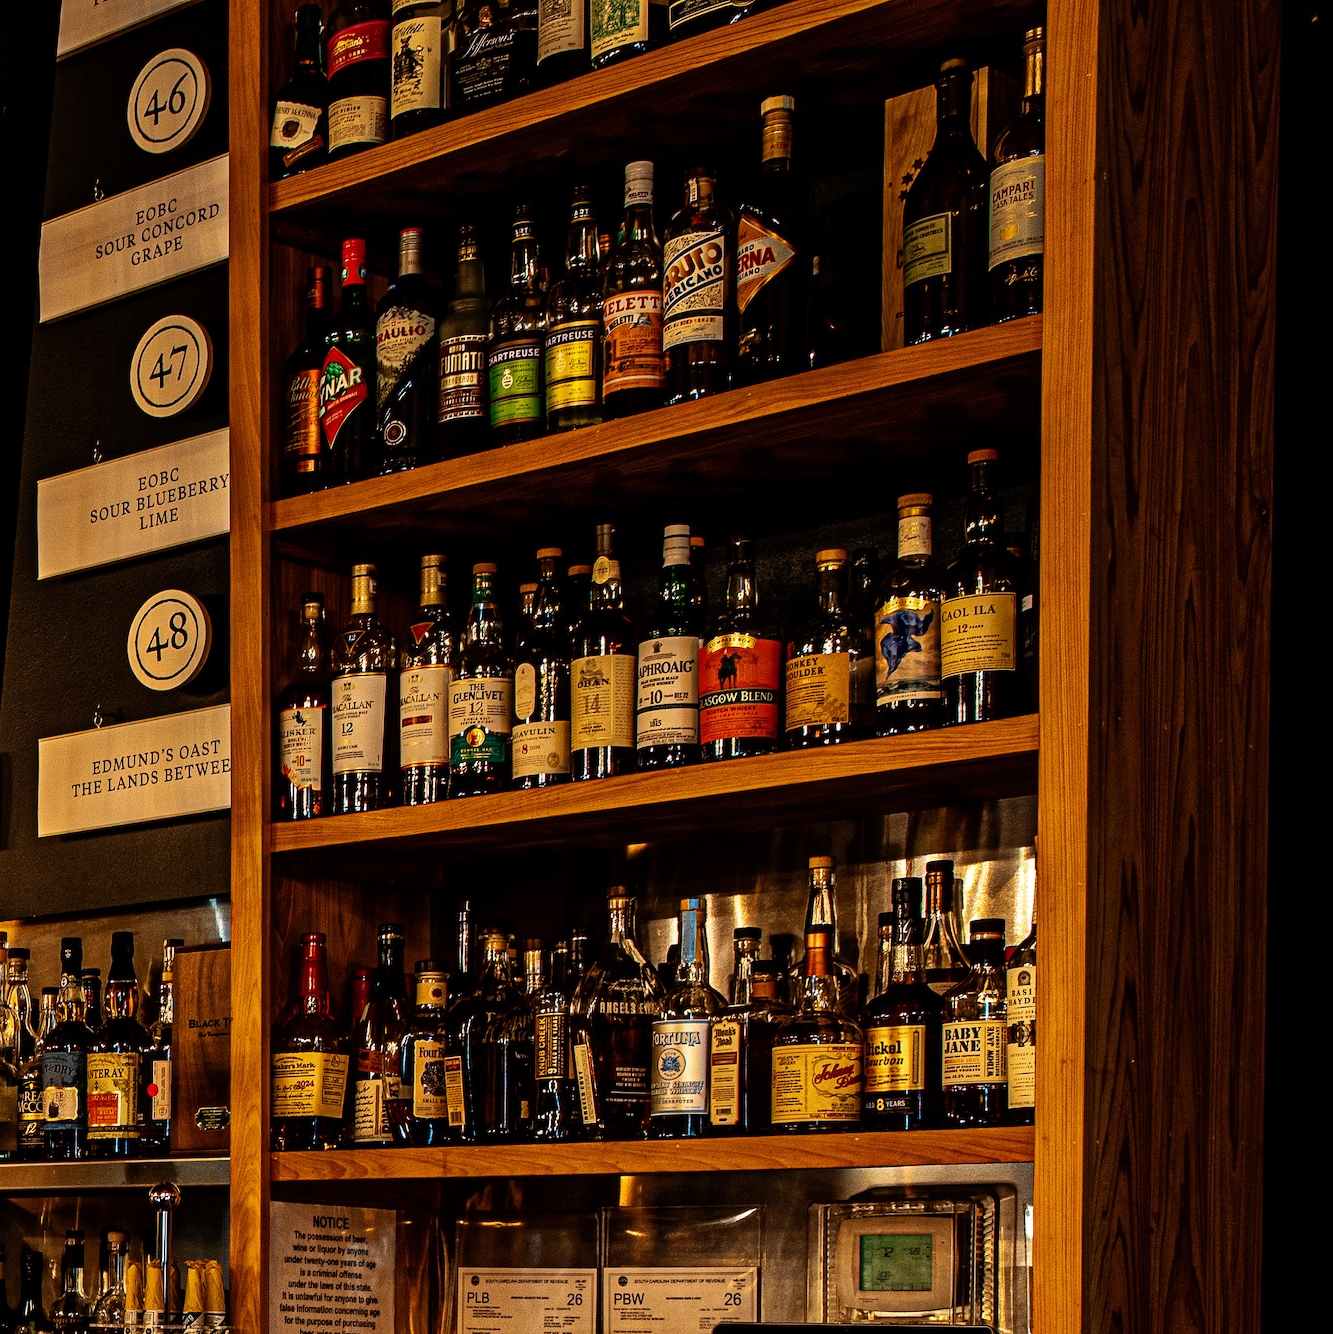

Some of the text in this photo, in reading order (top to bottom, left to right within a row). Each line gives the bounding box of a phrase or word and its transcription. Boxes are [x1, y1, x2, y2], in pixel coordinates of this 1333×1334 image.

[143, 72, 188, 125] 46
[136, 199, 178, 225] EOBC
[95, 203, 220, 259] SOUR CONCORD
[131, 236, 183, 266] GRAPE
[149, 345, 188, 388] 47
[138, 468, 180, 492] EOBC
[90, 473, 230, 524] SOUR BLUEBERRY
[139, 508, 179, 530] LIME
[941, 604, 996, 623] CAOL ILA
[957, 623, 968, 633] 12
[146, 612, 188, 661] 48
[468, 683, 485, 692] THE
[577, 678, 610, 689] OBAN
[453, 690, 504, 705] GLENLIVET
[650, 689, 663, 705] 10
[741, 689, 774, 702] BLEND
[469, 702, 484, 714] 12
[341, 722, 353, 734] 12
[521, 743, 529, 754] 8
[92, 740, 220, 775] EDMUND'S OAST
[295, 755, 305, 767] 10
[72, 780, 102, 798] THE
[108, 771, 159, 792] LANDS
[944, 1027, 981, 1041] BABY
[987, 1027, 995, 1047] JANE
[944, 1040, 980, 1054] JANE
[877, 1098, 905, 1111] 8 YEARS
[313, 1216, 349, 1229] NOTICE
[294, 1231, 305, 1240] The
[308, 1233, 343, 1242] possession
[353, 1235, 368, 1244] beer,
[312, 1269, 337, 1278] criminal
[339, 1270, 362, 1279] offense
[467, 1292, 489, 1303] PLB
[567, 1294, 582, 1305] 26
[614, 1293, 644, 1304] PBW
[724, 1293, 741, 1306] 26
